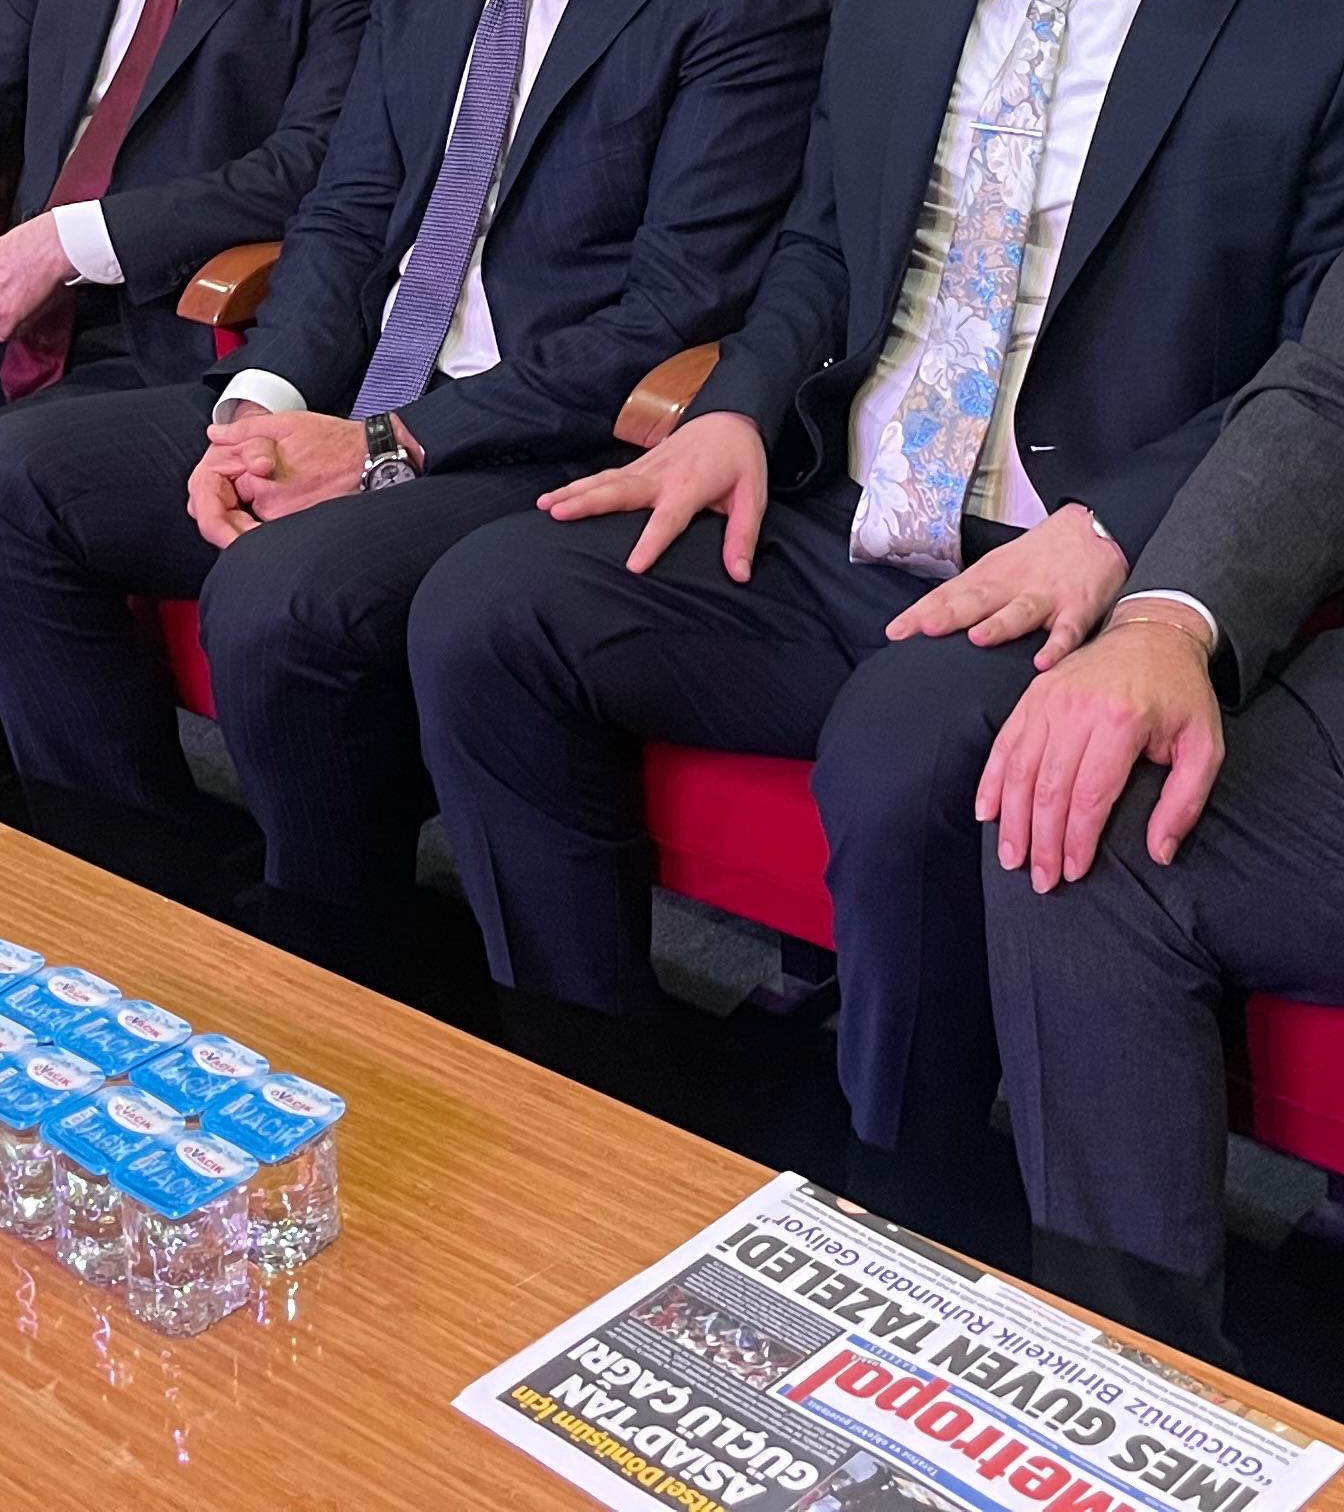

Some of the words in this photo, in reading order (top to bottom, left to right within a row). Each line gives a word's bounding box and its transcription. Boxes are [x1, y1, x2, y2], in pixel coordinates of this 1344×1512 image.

[714, 1223, 940, 1355] TAZELEDİ
[864, 1261, 994, 1333] Ruhundan
[510, 1385, 557, 1421] İçin
[565, 1337, 689, 1412] ÇAĞRI
[927, 1333, 1116, 1445] GÜVEN
[993, 1329, 1124, 1403] Birliktelik
[549, 1408, 662, 1483] Dönüşüm
[674, 1403, 819, 1491] GÜÇLÜ
[781, 1348, 1137, 1511] Metropol
